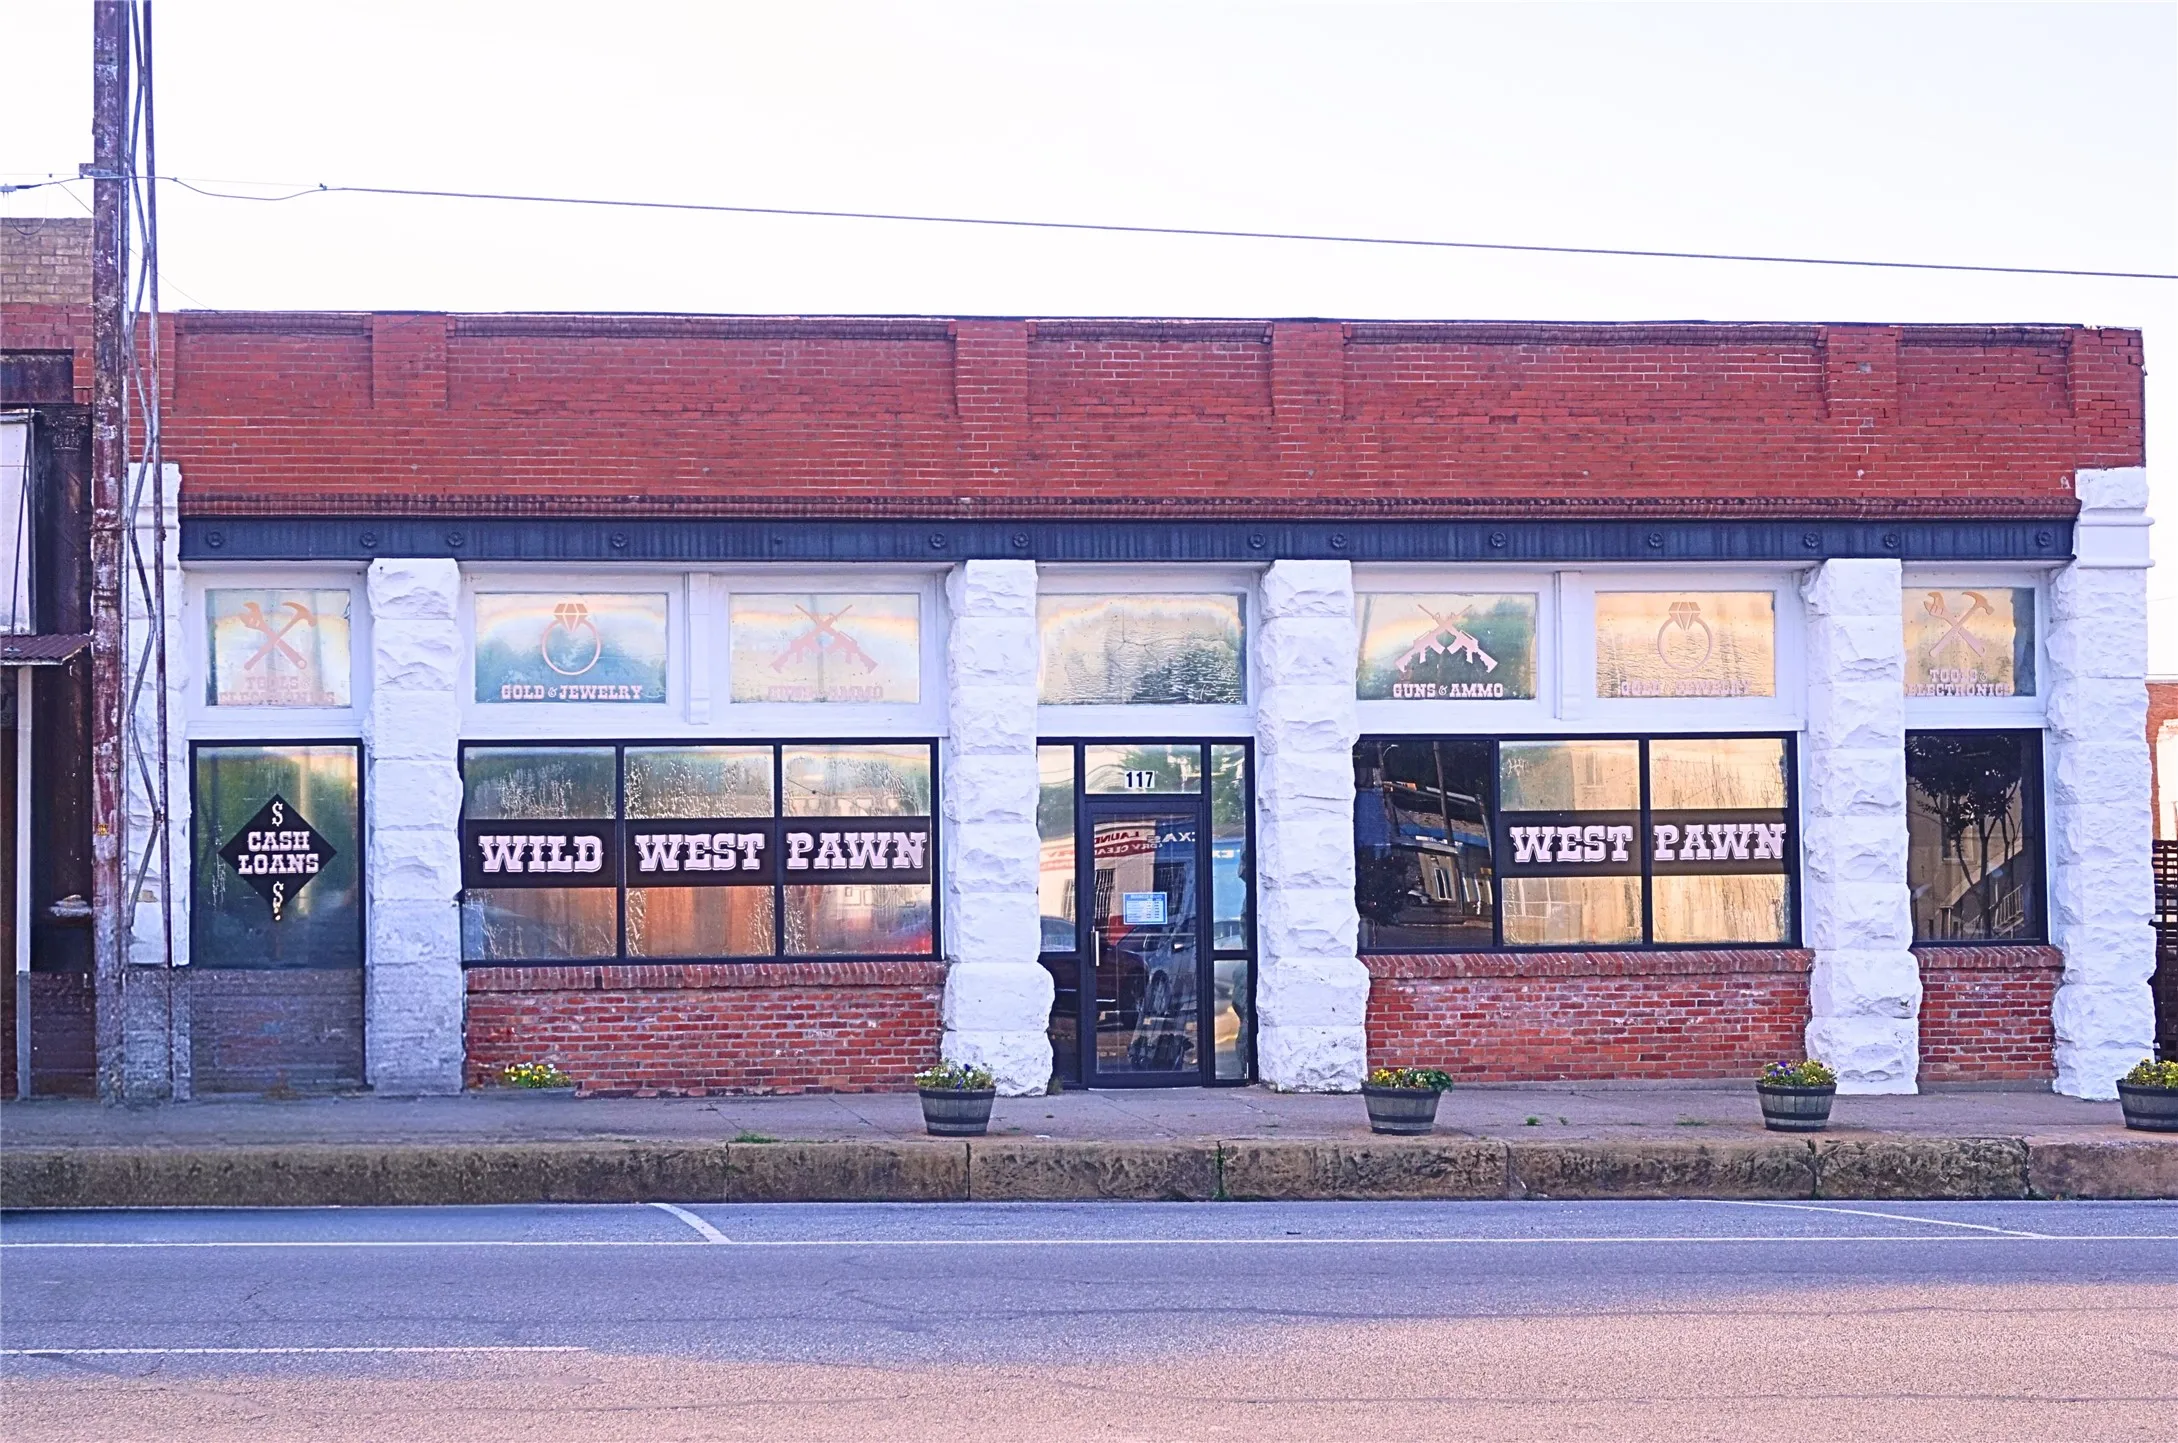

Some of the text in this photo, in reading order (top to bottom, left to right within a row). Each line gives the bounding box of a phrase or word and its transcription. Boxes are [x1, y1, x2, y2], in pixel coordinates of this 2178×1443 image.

[502, 685, 643, 699] GOLD & JEWELRY
[1393, 683, 1504, 698] GUNS & AMMO
[1126, 771, 1153, 788] 117
[247, 831, 310, 852] CASH
[1509, 823, 1786, 863] WEST PAWN
[478, 832, 928, 873] WILD WEST PAWN
[237, 853, 319, 875] LOANS
